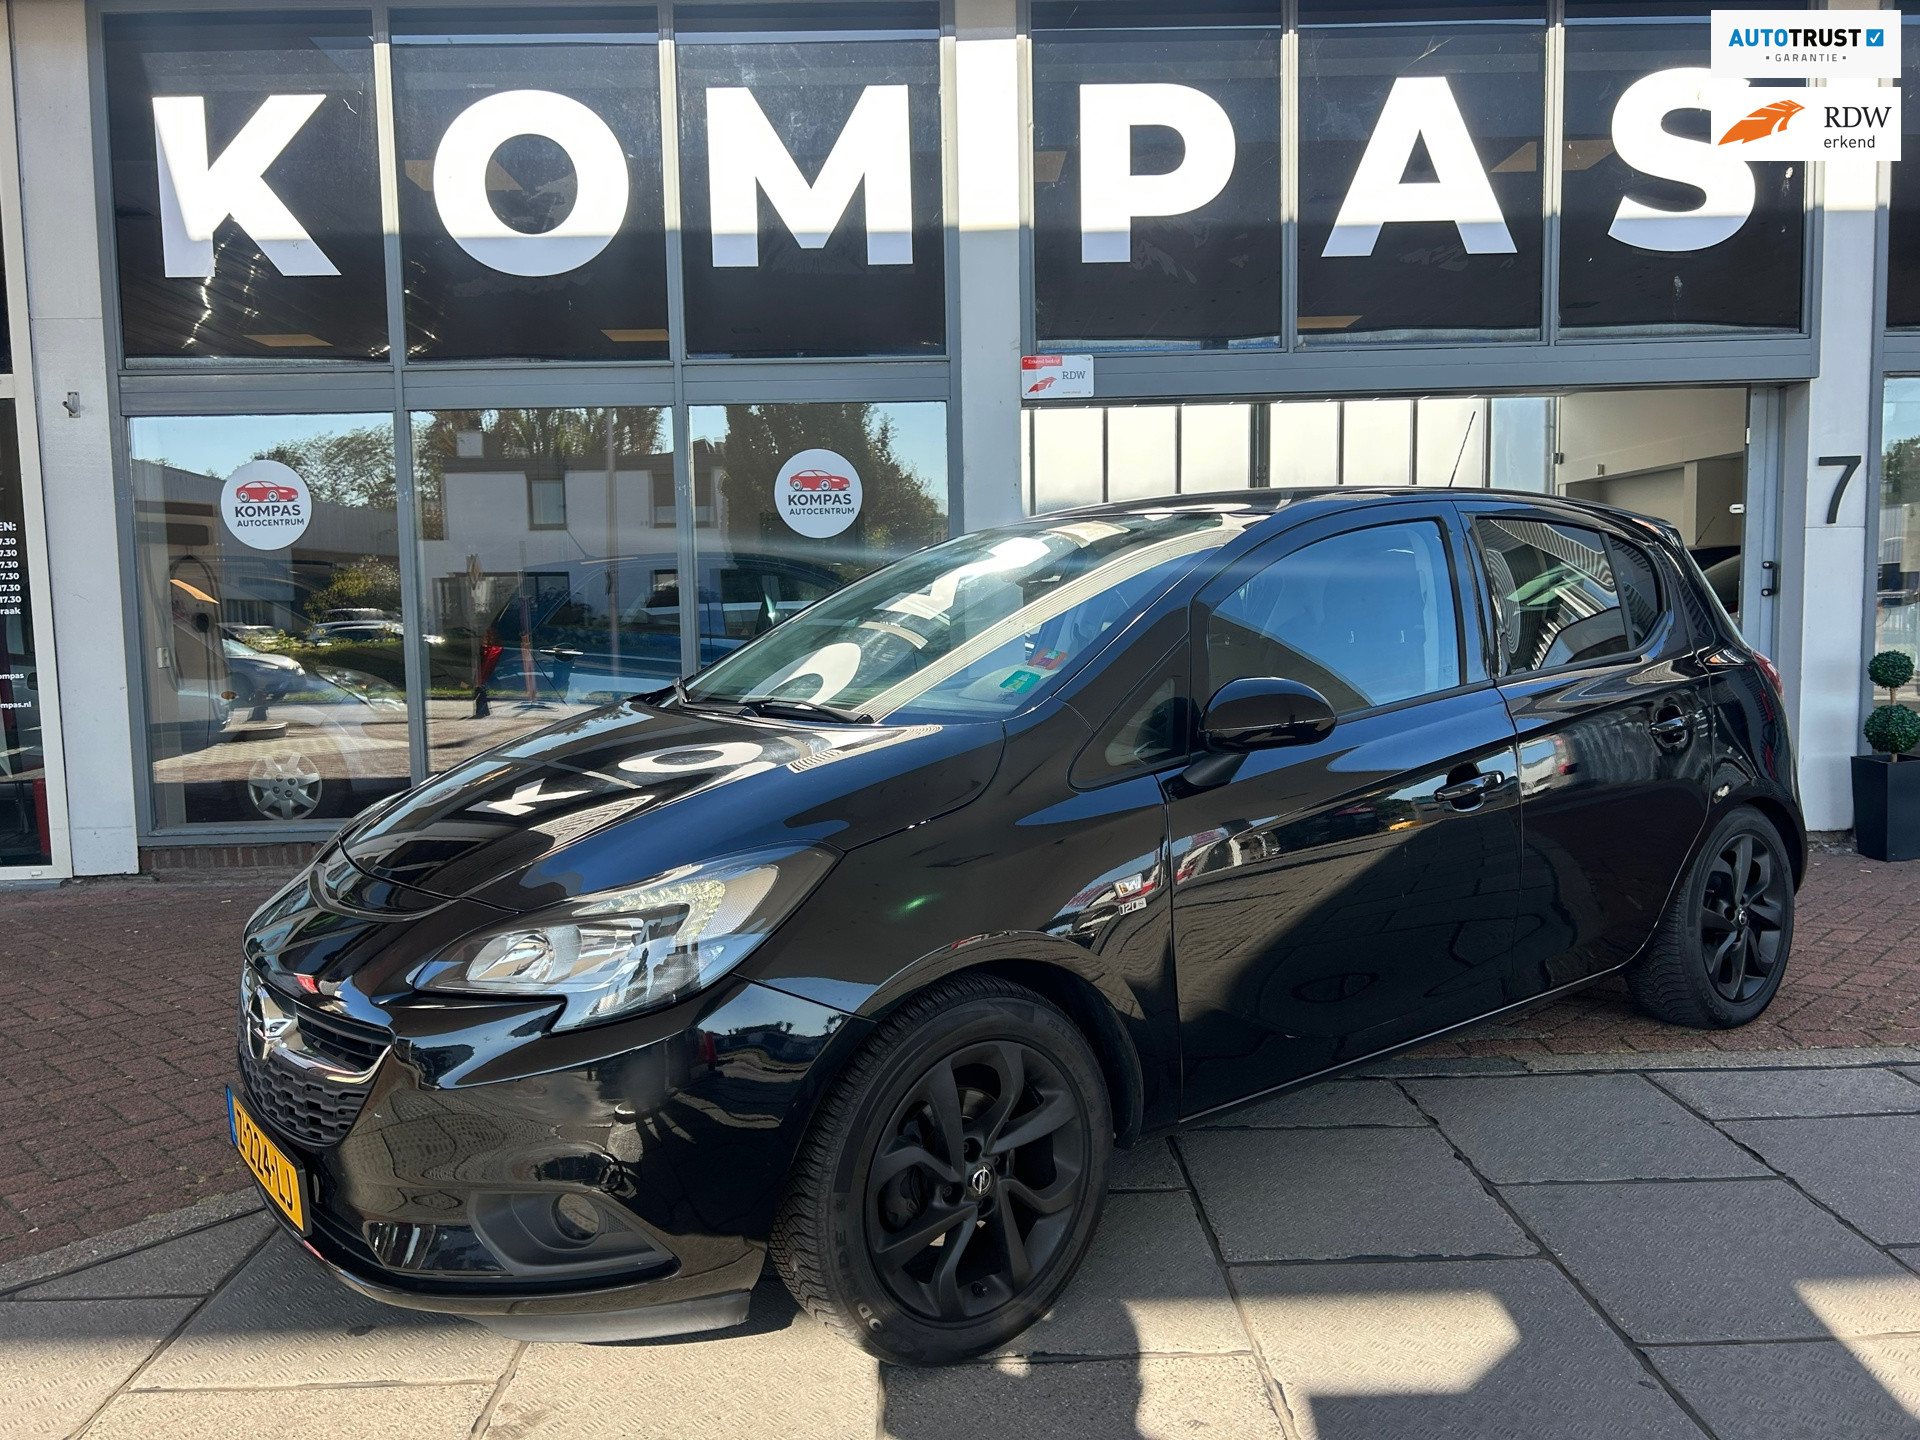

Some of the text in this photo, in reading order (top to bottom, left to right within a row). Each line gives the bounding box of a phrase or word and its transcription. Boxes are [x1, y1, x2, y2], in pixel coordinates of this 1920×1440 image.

[152, 67, 1756, 278] KOMPAS
[1062, 370, 1086, 380] RDW
[1818, 455, 1862, 525] 7
[787, 493, 852, 506] KOMPAS
[234, 504, 301, 518] KOMPAS
[789, 507, 855, 516] AUTOCENTRUM
[236, 518, 305, 528] AUTOCENTRUM
